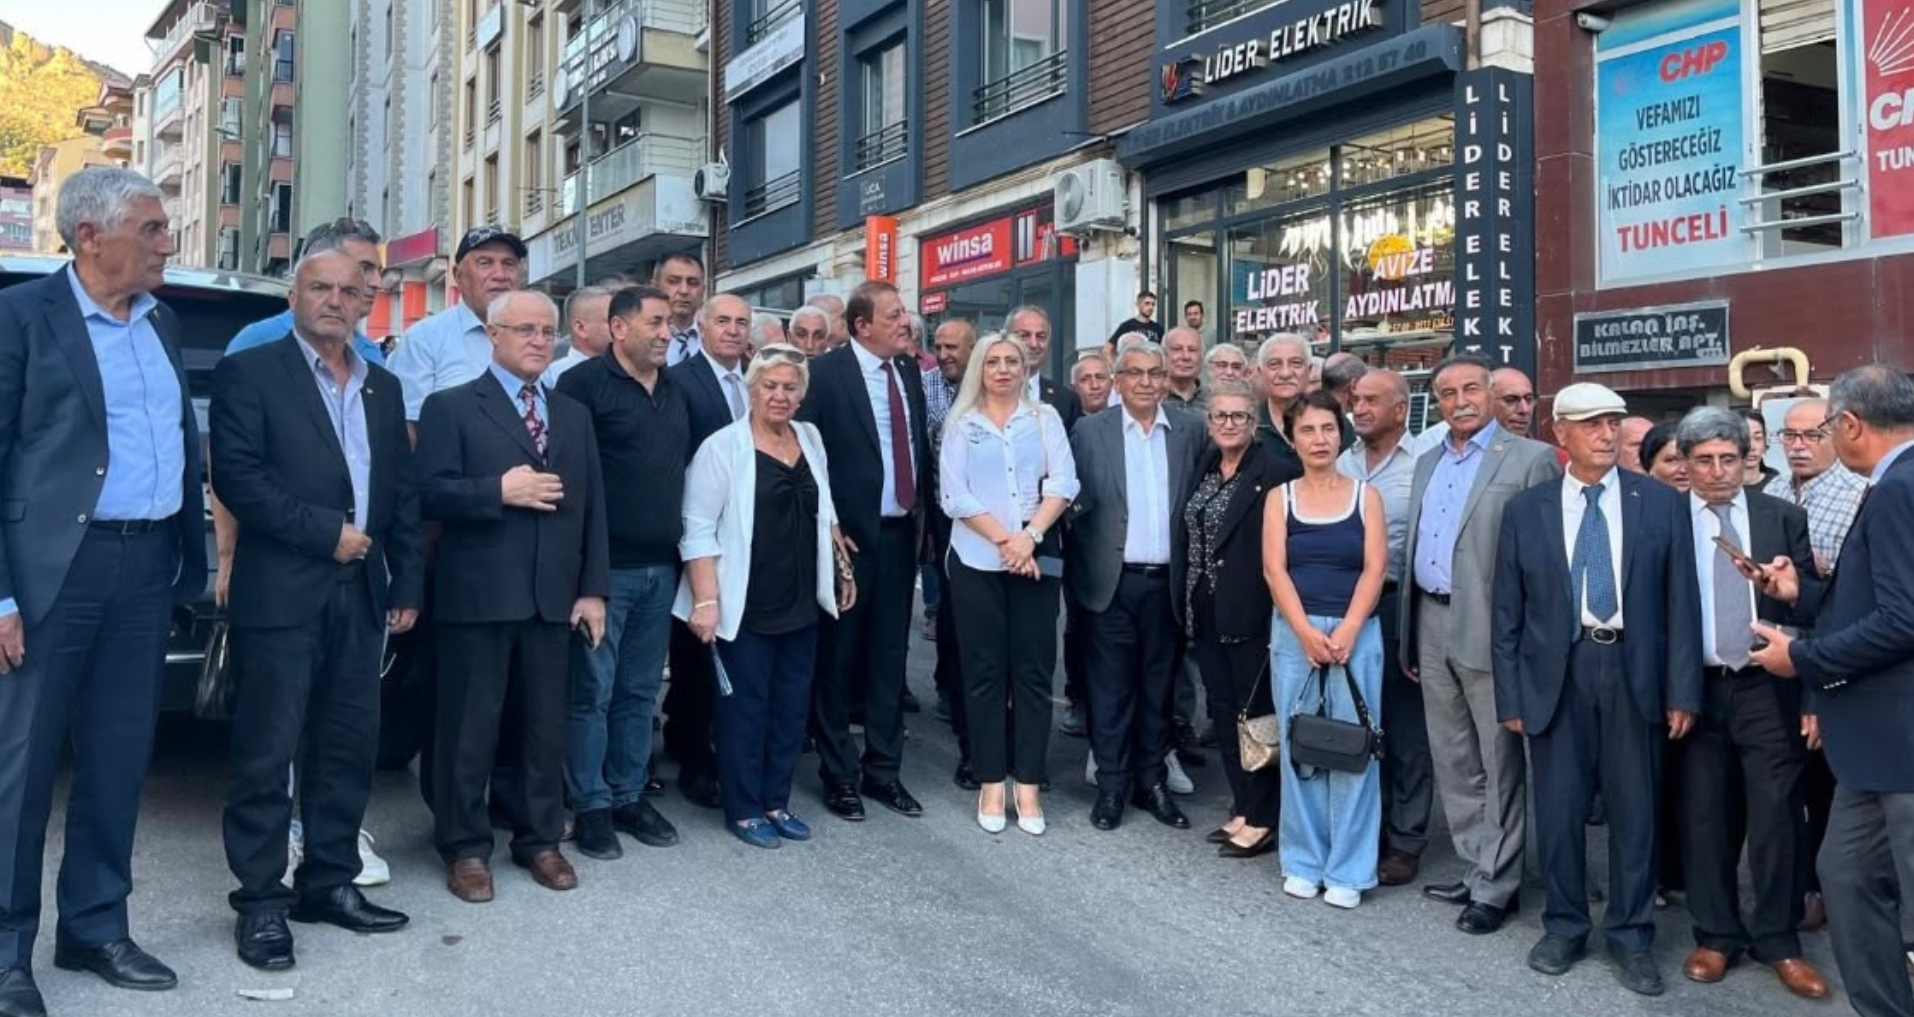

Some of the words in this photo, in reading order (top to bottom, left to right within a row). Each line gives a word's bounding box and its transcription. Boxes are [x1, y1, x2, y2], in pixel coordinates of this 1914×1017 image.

[1659, 41, 1728, 83] CHP
[1636, 96, 1701, 131] VEFAMIZI
[1465, 86, 1482, 218] LİDER
[1498, 84, 1512, 217] LİDER
[1618, 125, 1722, 171] GÖSTERECEĞİZ
[1607, 177, 1662, 210] İKTİDAR
[1664, 163, 1736, 201] OLACAĞIZ
[937, 232, 994, 265] winsa
[1617, 204, 1727, 253] TUNCELİ
[1247, 263, 1310, 301] LİDER
[1236, 300, 1319, 333] ELEKTRİK
[1579, 336, 1674, 358] BİLMEZLER
[1679, 332, 1722, 351] APT.
